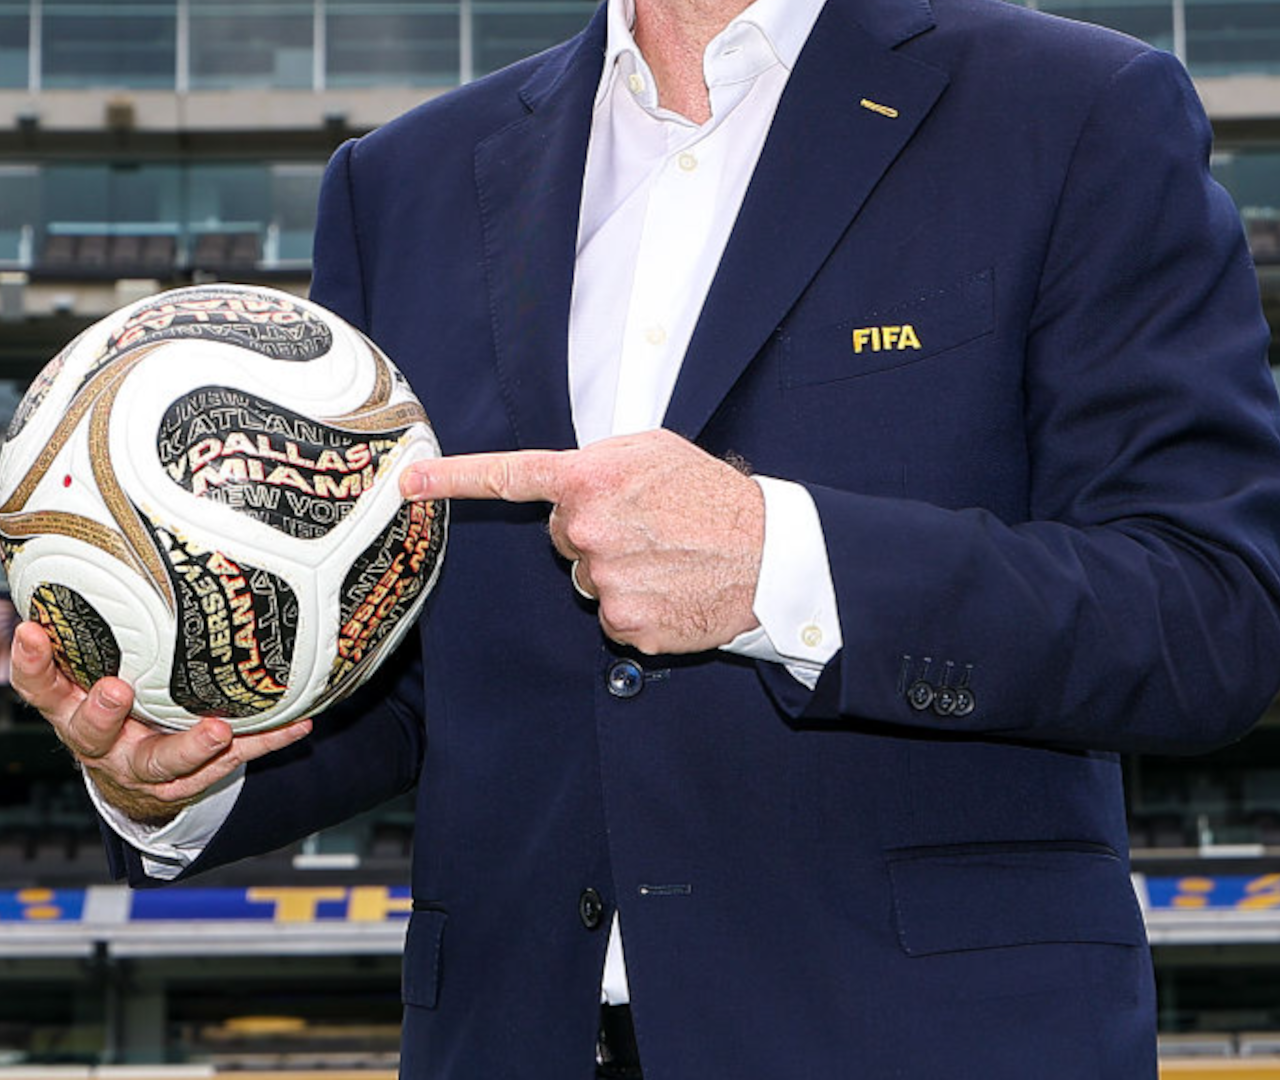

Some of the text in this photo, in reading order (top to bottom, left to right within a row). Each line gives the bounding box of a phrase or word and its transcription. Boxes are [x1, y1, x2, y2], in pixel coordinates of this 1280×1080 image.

[852, 324, 922, 353] FIFA
[188, 407, 338, 446] ATLAN
[187, 431, 372, 473] DALLAS
[191, 457, 376, 498] MIAMI
[285, 491, 357, 524] YOR
[173, 564, 233, 664] JERSEY
[206, 550, 290, 693] ATLANTA
[246, 886, 413, 921] TH
